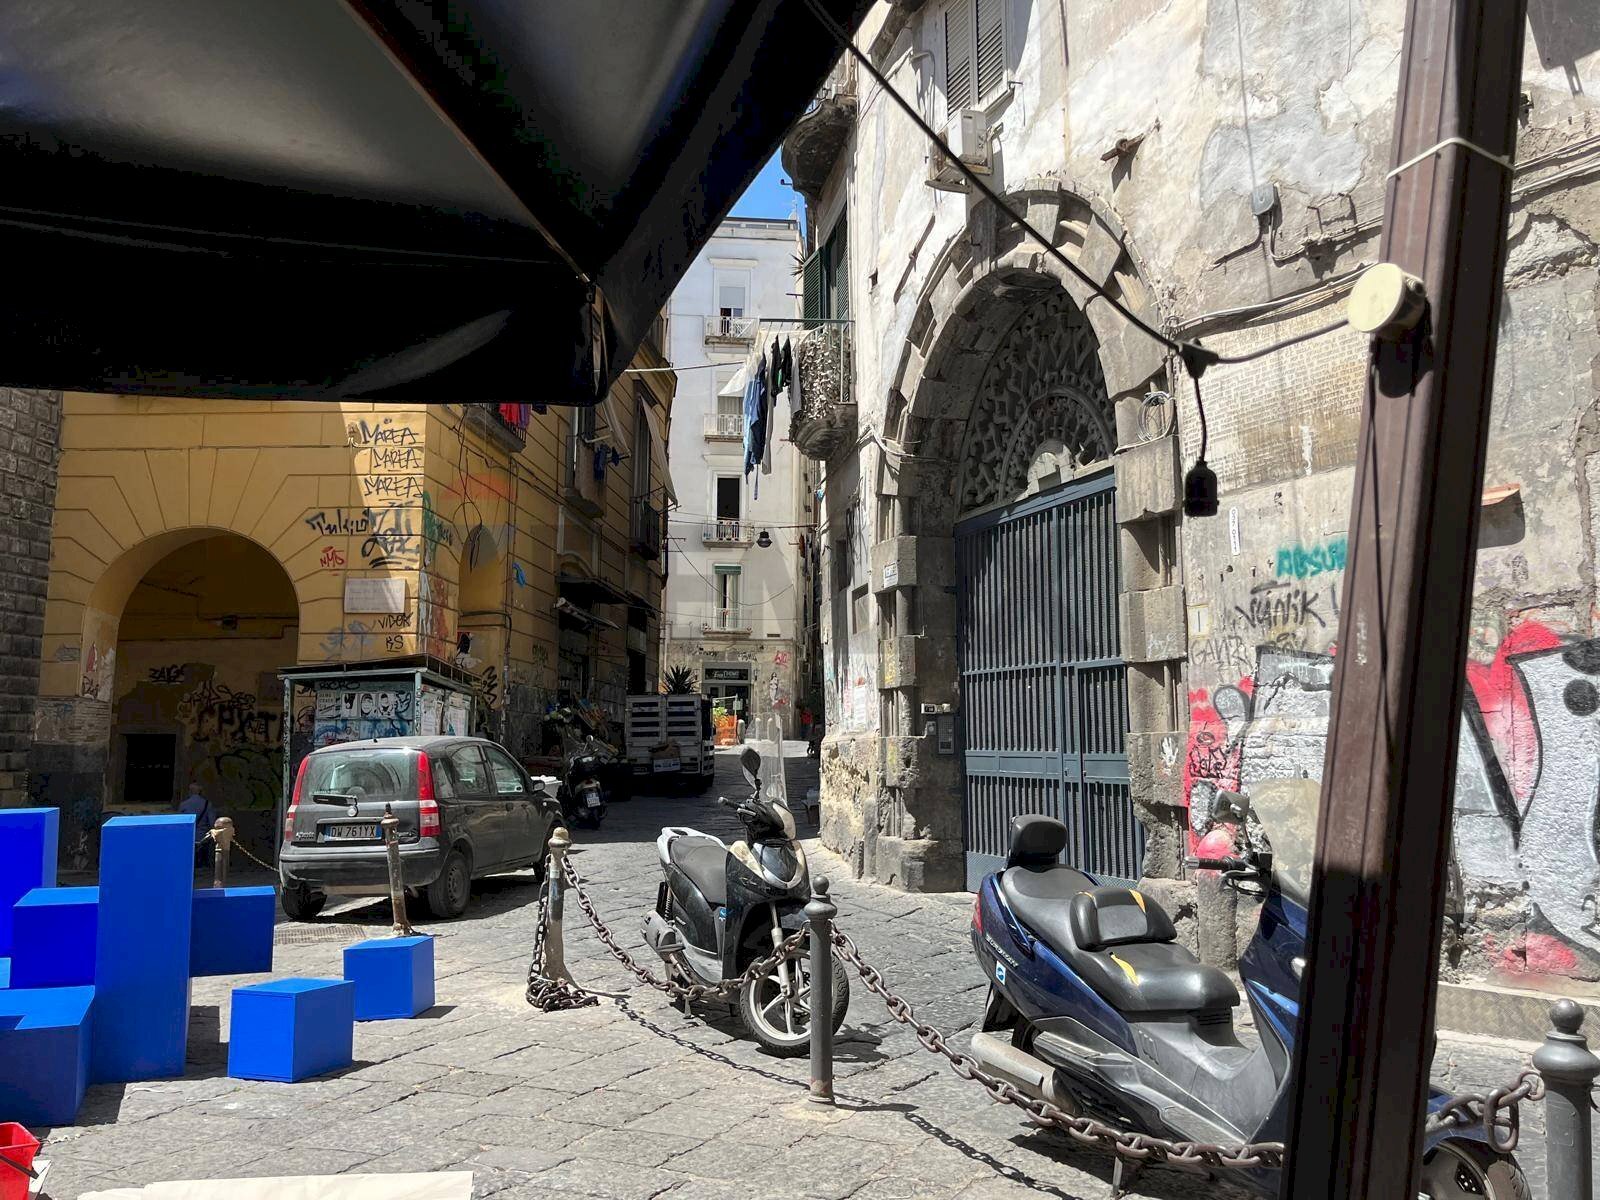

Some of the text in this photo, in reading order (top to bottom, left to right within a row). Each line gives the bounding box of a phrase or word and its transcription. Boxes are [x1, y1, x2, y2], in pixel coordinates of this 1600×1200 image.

[373, 448, 424, 469] MAREA
[364, 475, 424, 499] MAREA
[331, 826, 375, 838] DW 761YX
